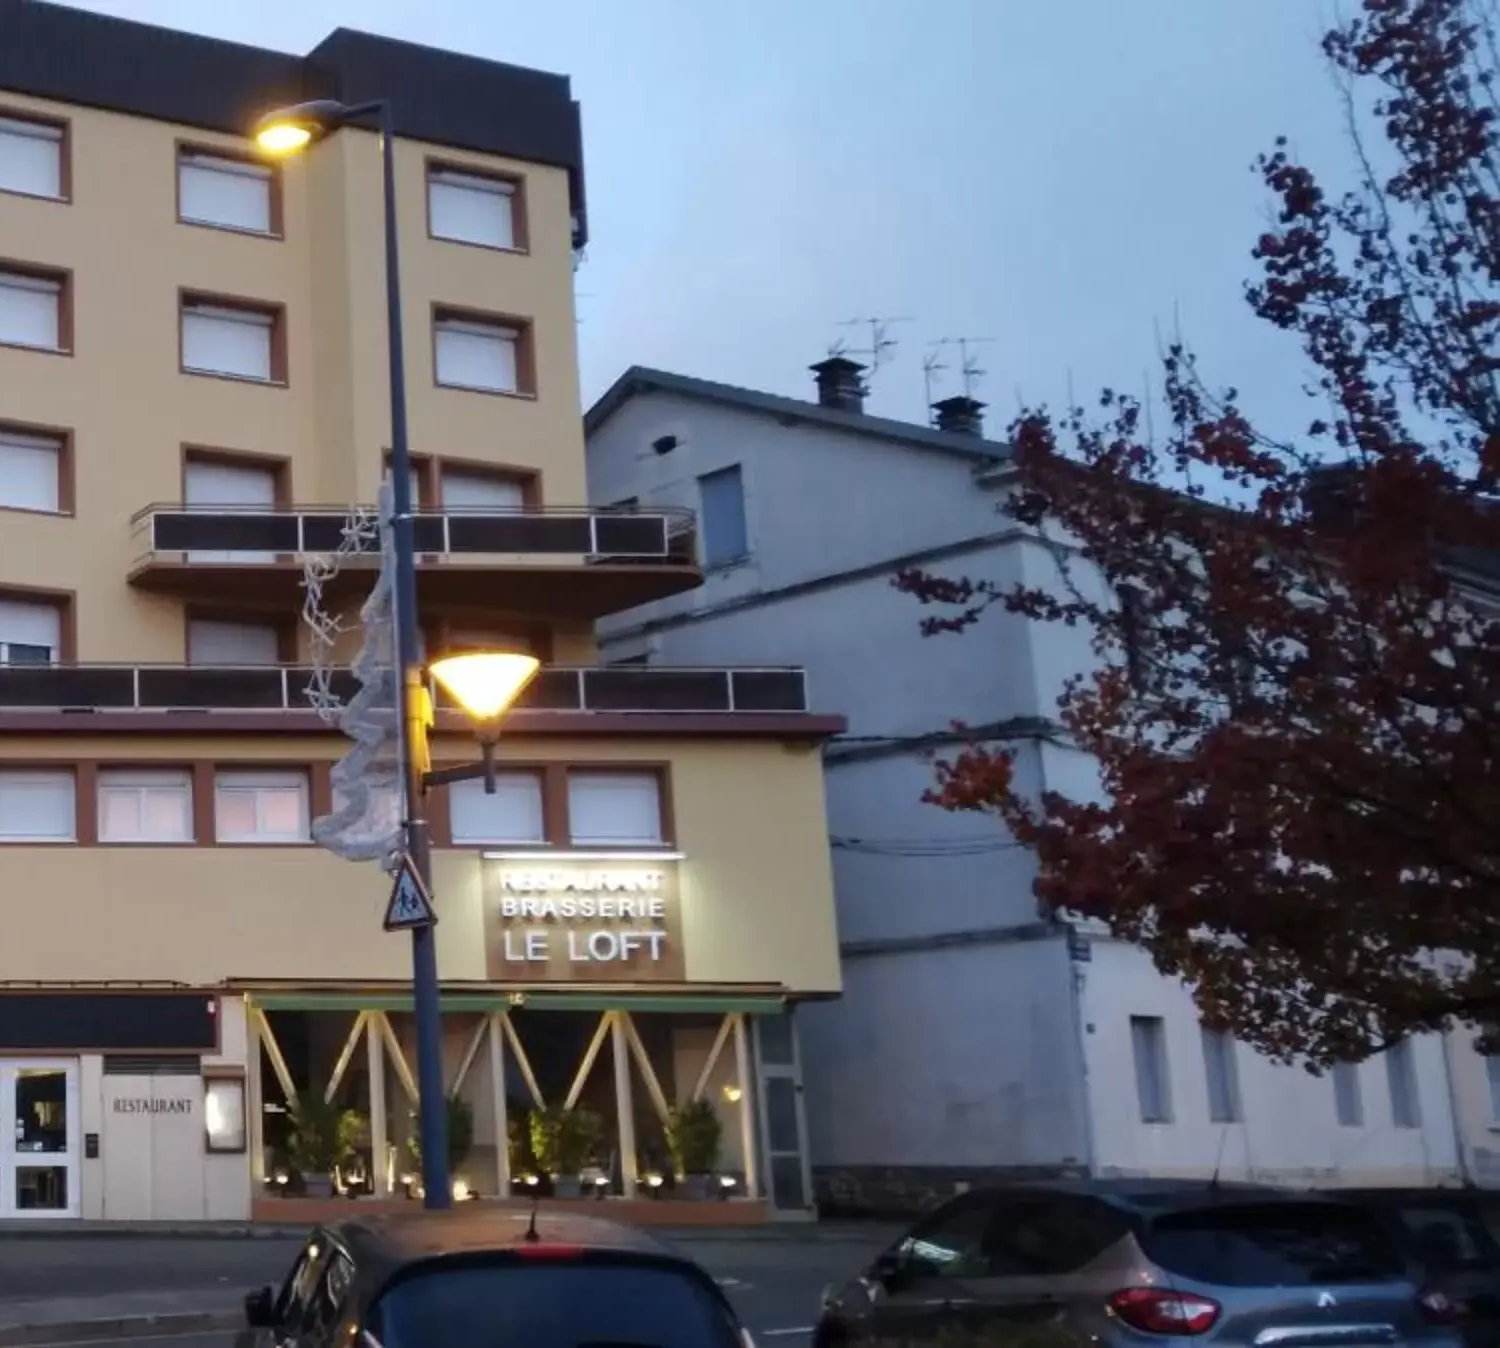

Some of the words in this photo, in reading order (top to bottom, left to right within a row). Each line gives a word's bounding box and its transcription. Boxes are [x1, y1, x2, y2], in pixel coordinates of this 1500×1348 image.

[501, 870, 666, 891] RESTAURANT
[501, 898, 665, 917] BRASSERIE
[505, 931, 550, 961] LE
[568, 931, 667, 962] LOFT
[113, 1098, 192, 1114] RESTAURANT
